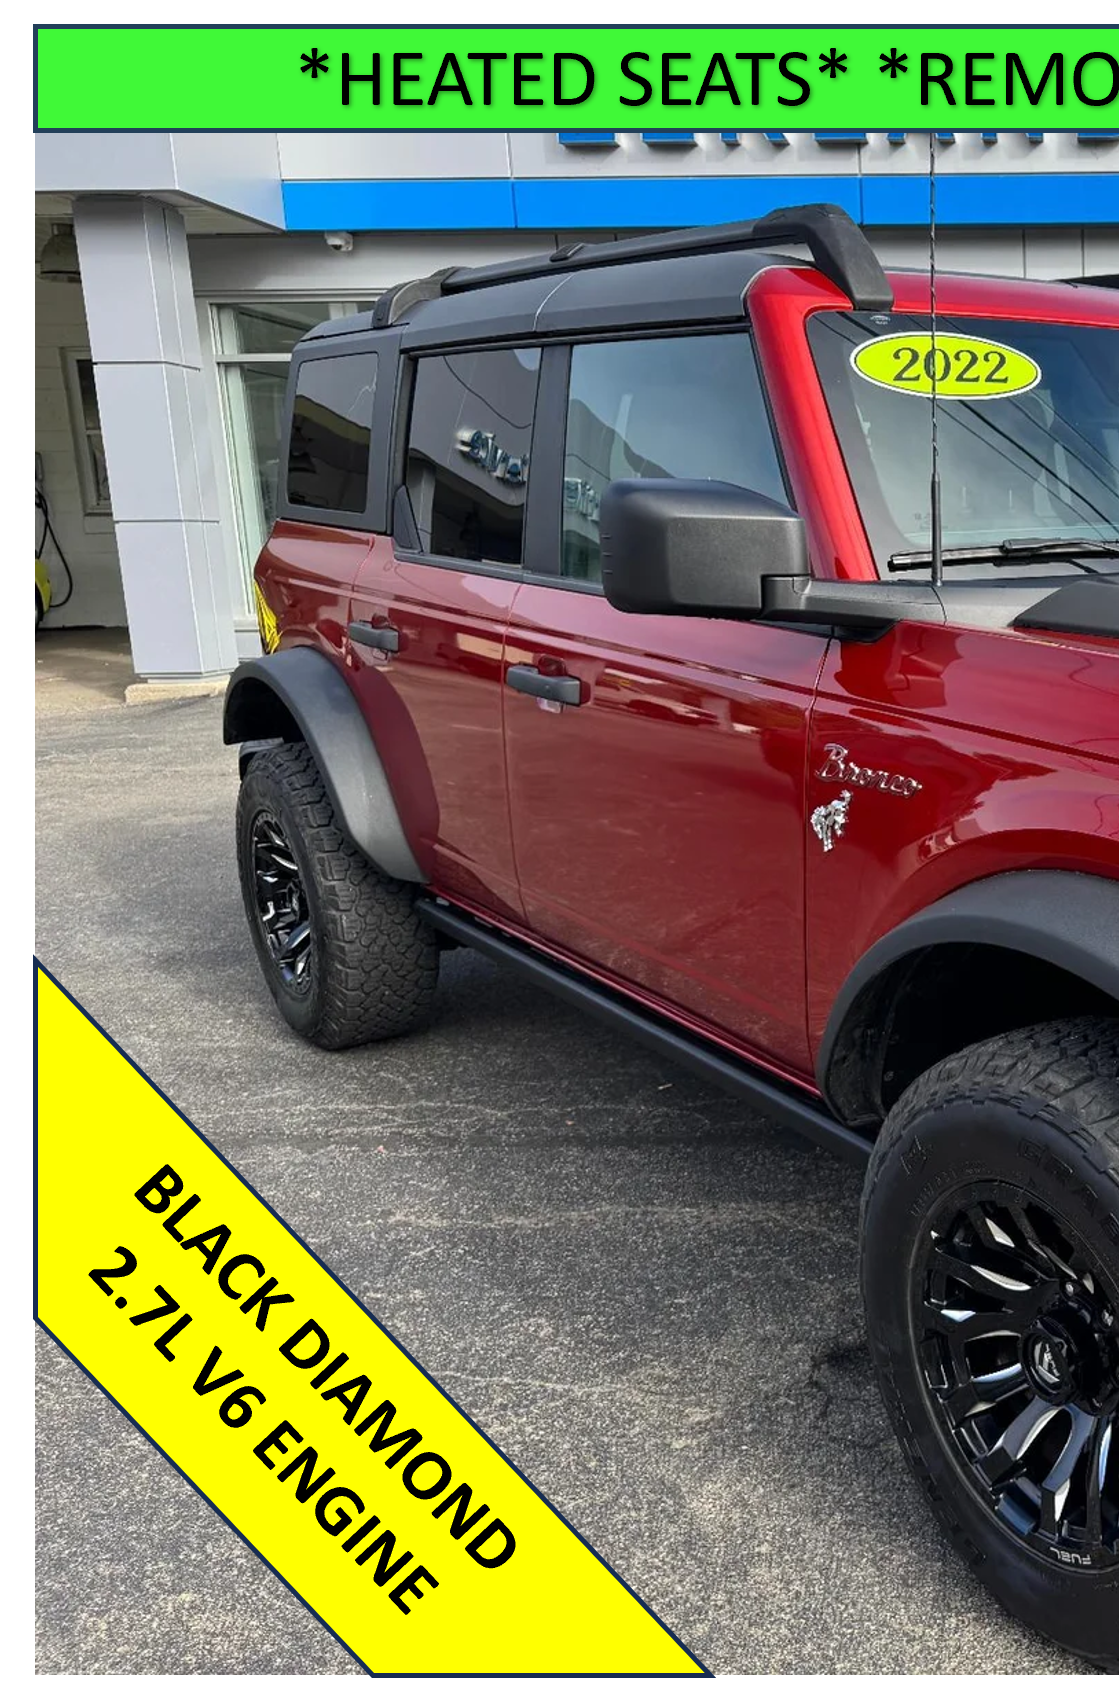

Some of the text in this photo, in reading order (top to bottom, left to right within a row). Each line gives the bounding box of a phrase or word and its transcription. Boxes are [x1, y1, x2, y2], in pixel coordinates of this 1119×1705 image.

[892, 347, 1009, 384] 2022
[815, 742, 923, 798] Bronco
[1050, 1546, 1092, 1565] FUEL
